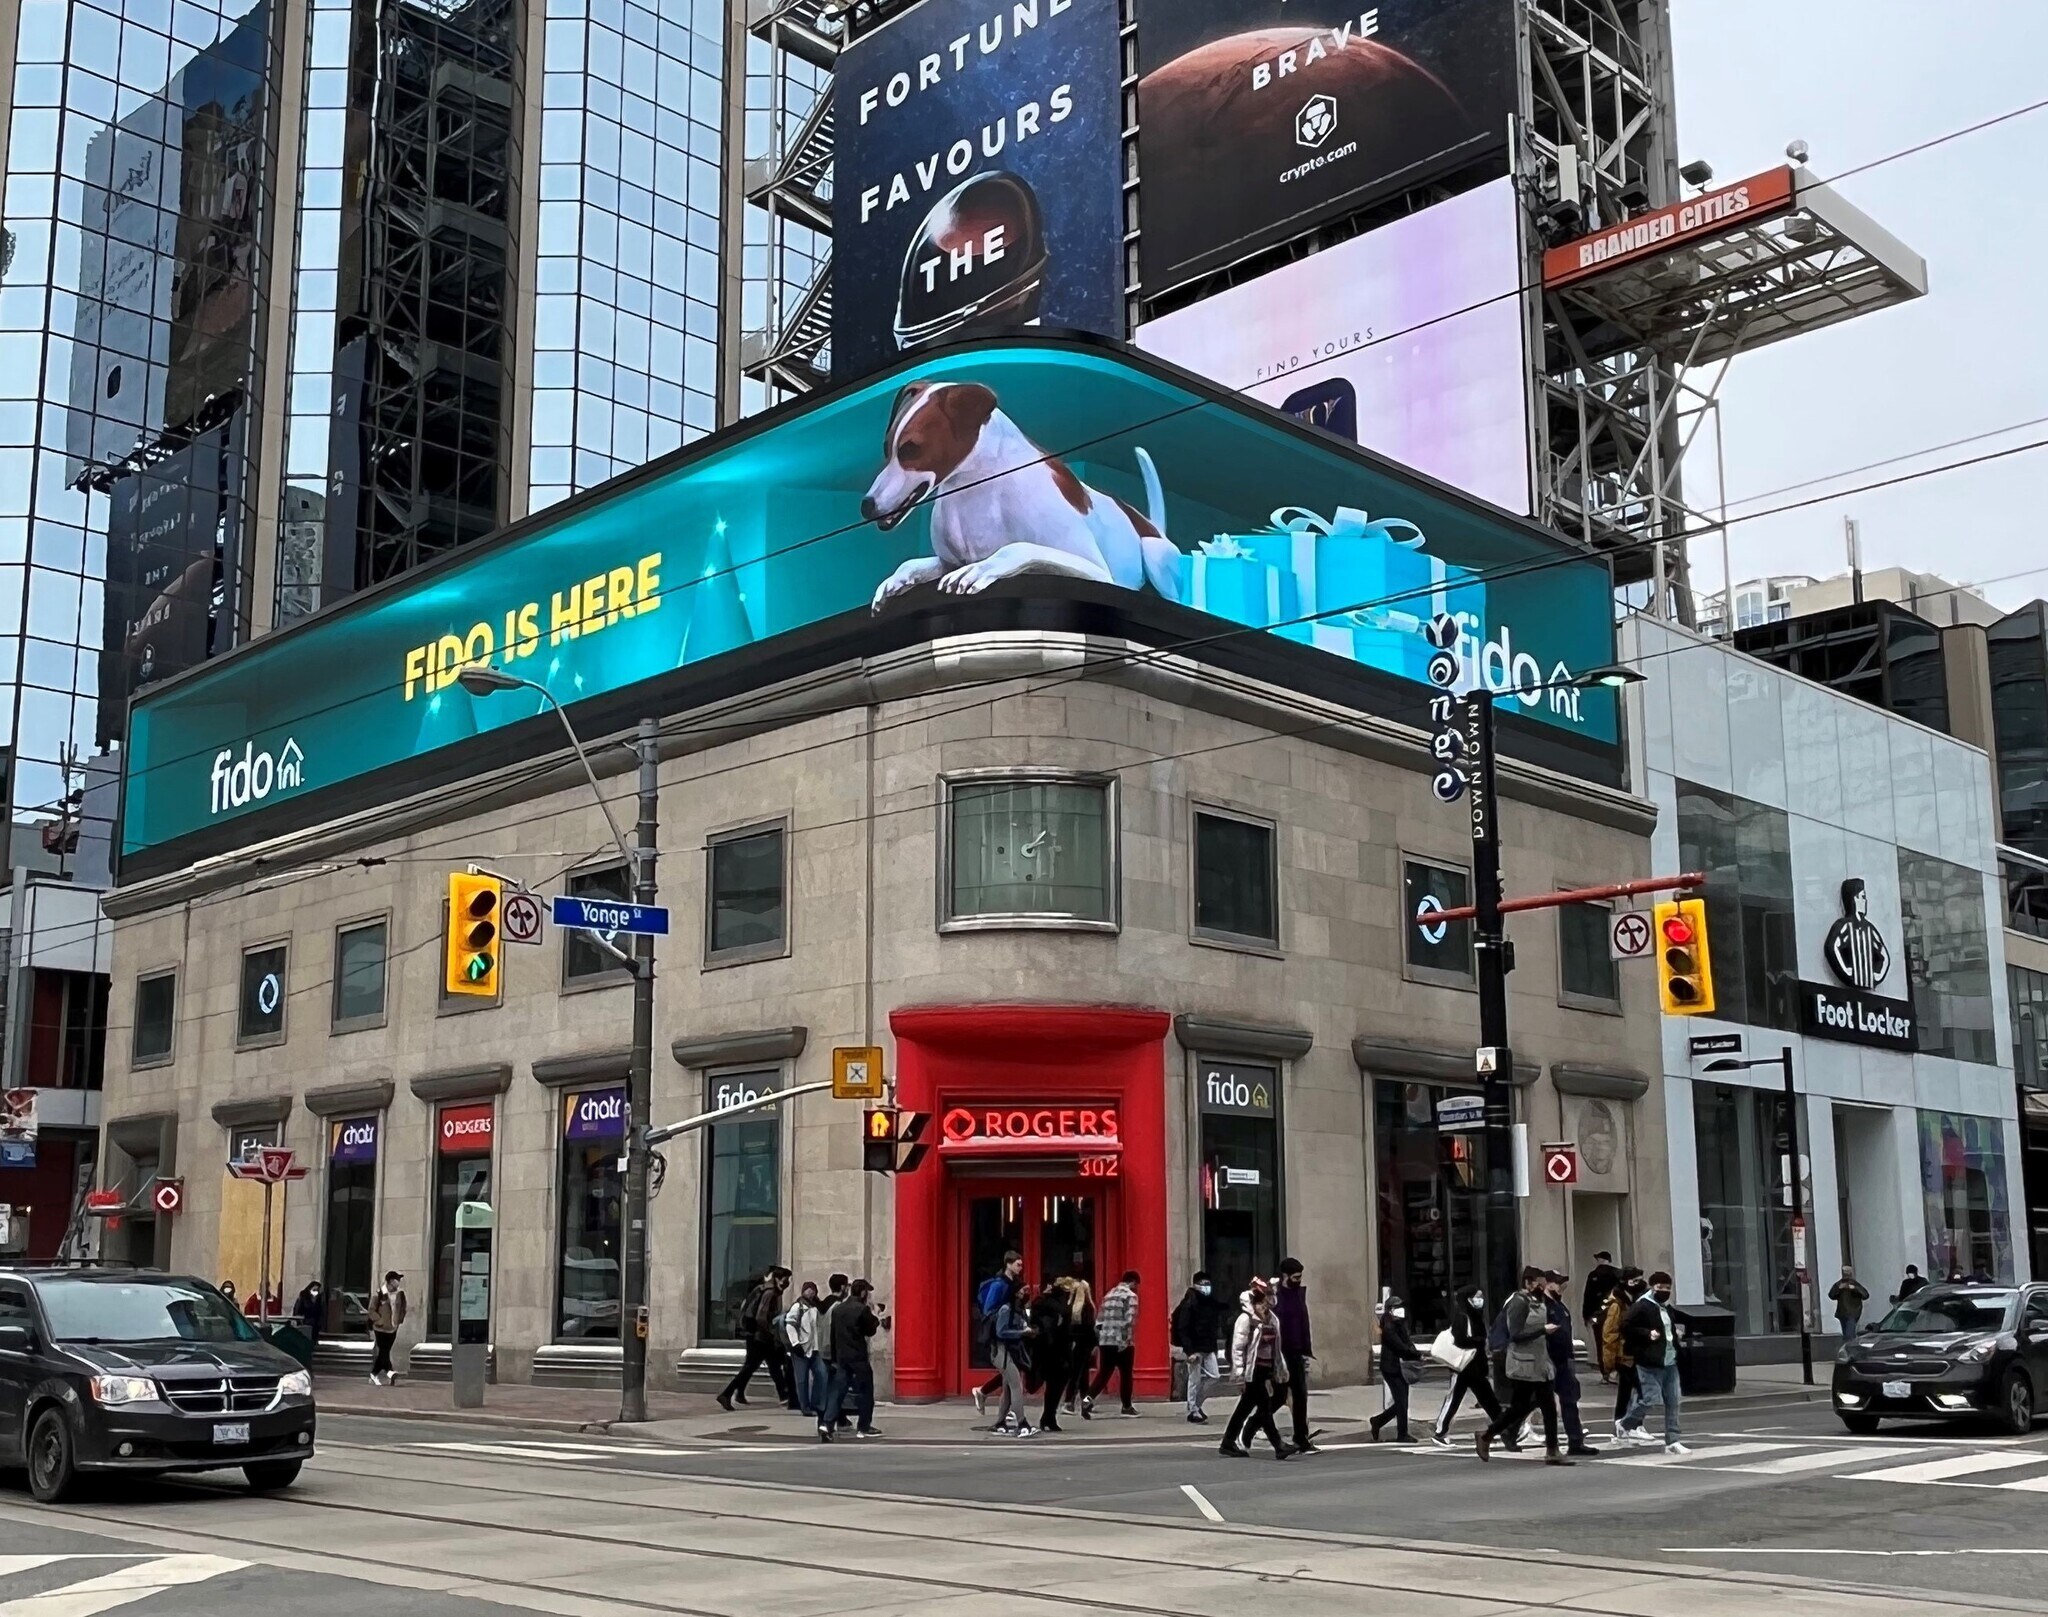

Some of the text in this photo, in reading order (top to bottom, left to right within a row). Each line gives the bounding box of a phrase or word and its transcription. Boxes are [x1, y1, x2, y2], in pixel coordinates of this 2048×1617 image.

[1252, 7, 1379, 91] BRAVE
[860, 84, 1073, 224] FAVOURS
[1279, 141, 1357, 183] crypto.com
[1579, 186, 1750, 268] BRANDED CITIES
[919, 225, 1005, 293] THE
[1256, 327, 1373, 379] FIND YOURS
[404, 552, 662, 702] FIDO IS HERE
[1454, 610, 1542, 707] fido
[210, 740, 274, 814] fido
[1467, 703, 1485, 840] DOWNTOWN
[580, 902, 630, 929] Yonge
[1815, 993, 1910, 1039] Foot Locker
[579, 1095, 622, 1122] chatr
[717, 1082, 758, 1113] fido
[1206, 1071, 1250, 1107] fido
[455, 1117, 492, 1135] ROGERS
[984, 1109, 1118, 1138] ROGERS
[1078, 1156, 1118, 1176] 302
